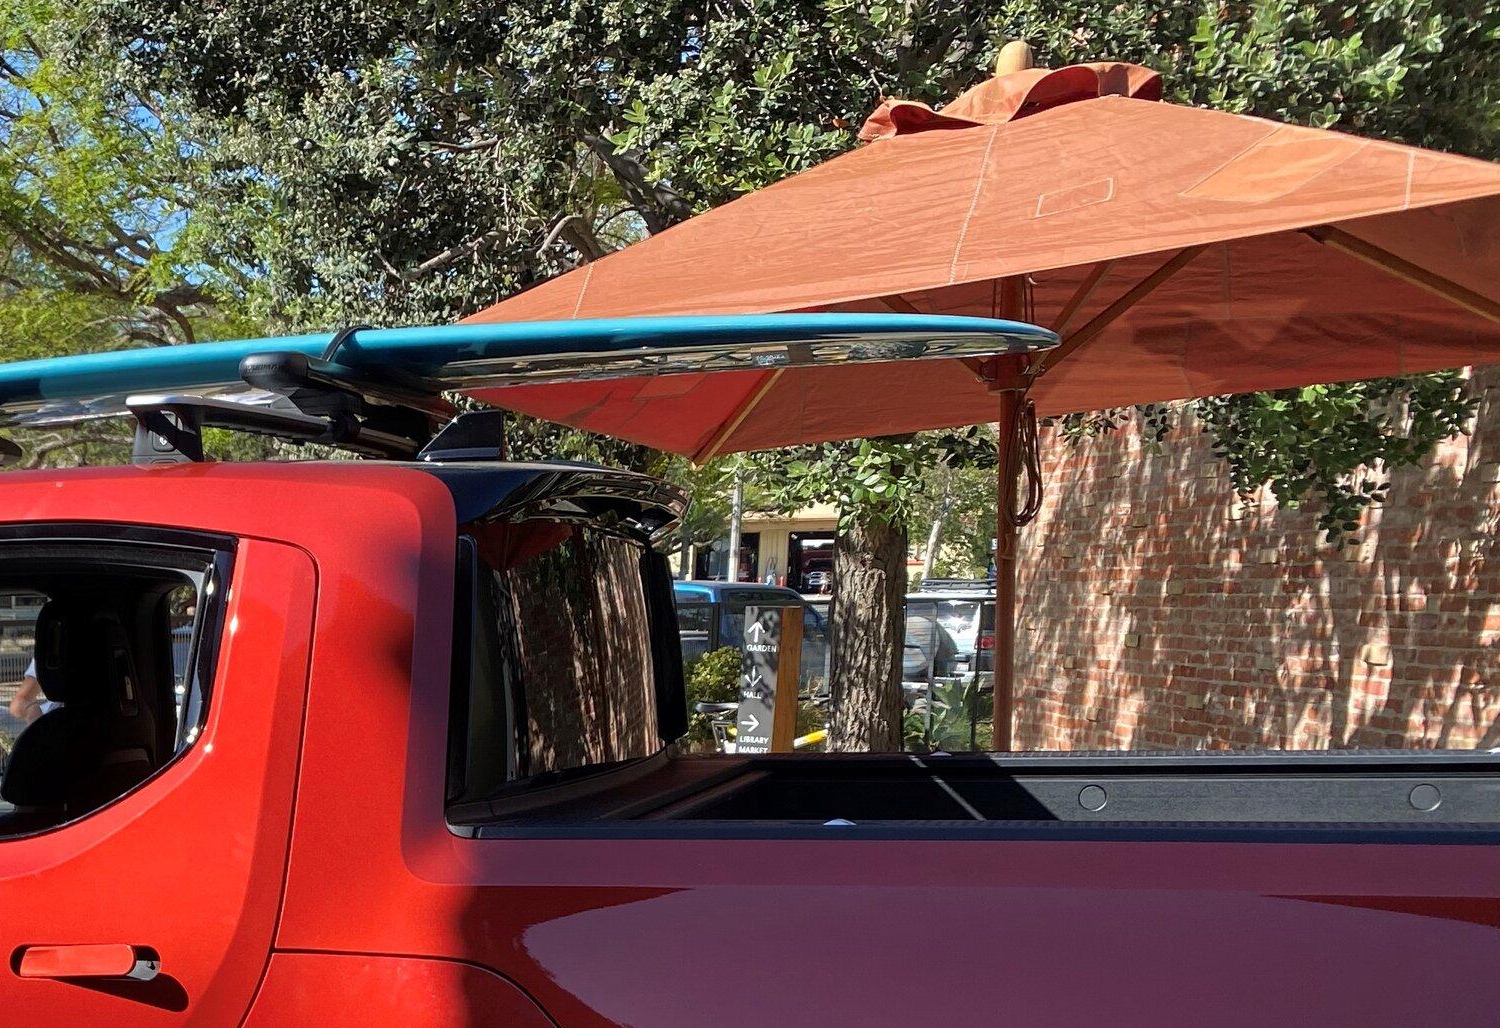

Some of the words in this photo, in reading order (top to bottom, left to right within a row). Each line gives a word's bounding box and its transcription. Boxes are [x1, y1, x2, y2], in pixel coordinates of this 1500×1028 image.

[746, 644, 777, 653] GARDEN
[743, 691, 762, 699] HALL
[739, 735, 769, 744] LIBRARY
